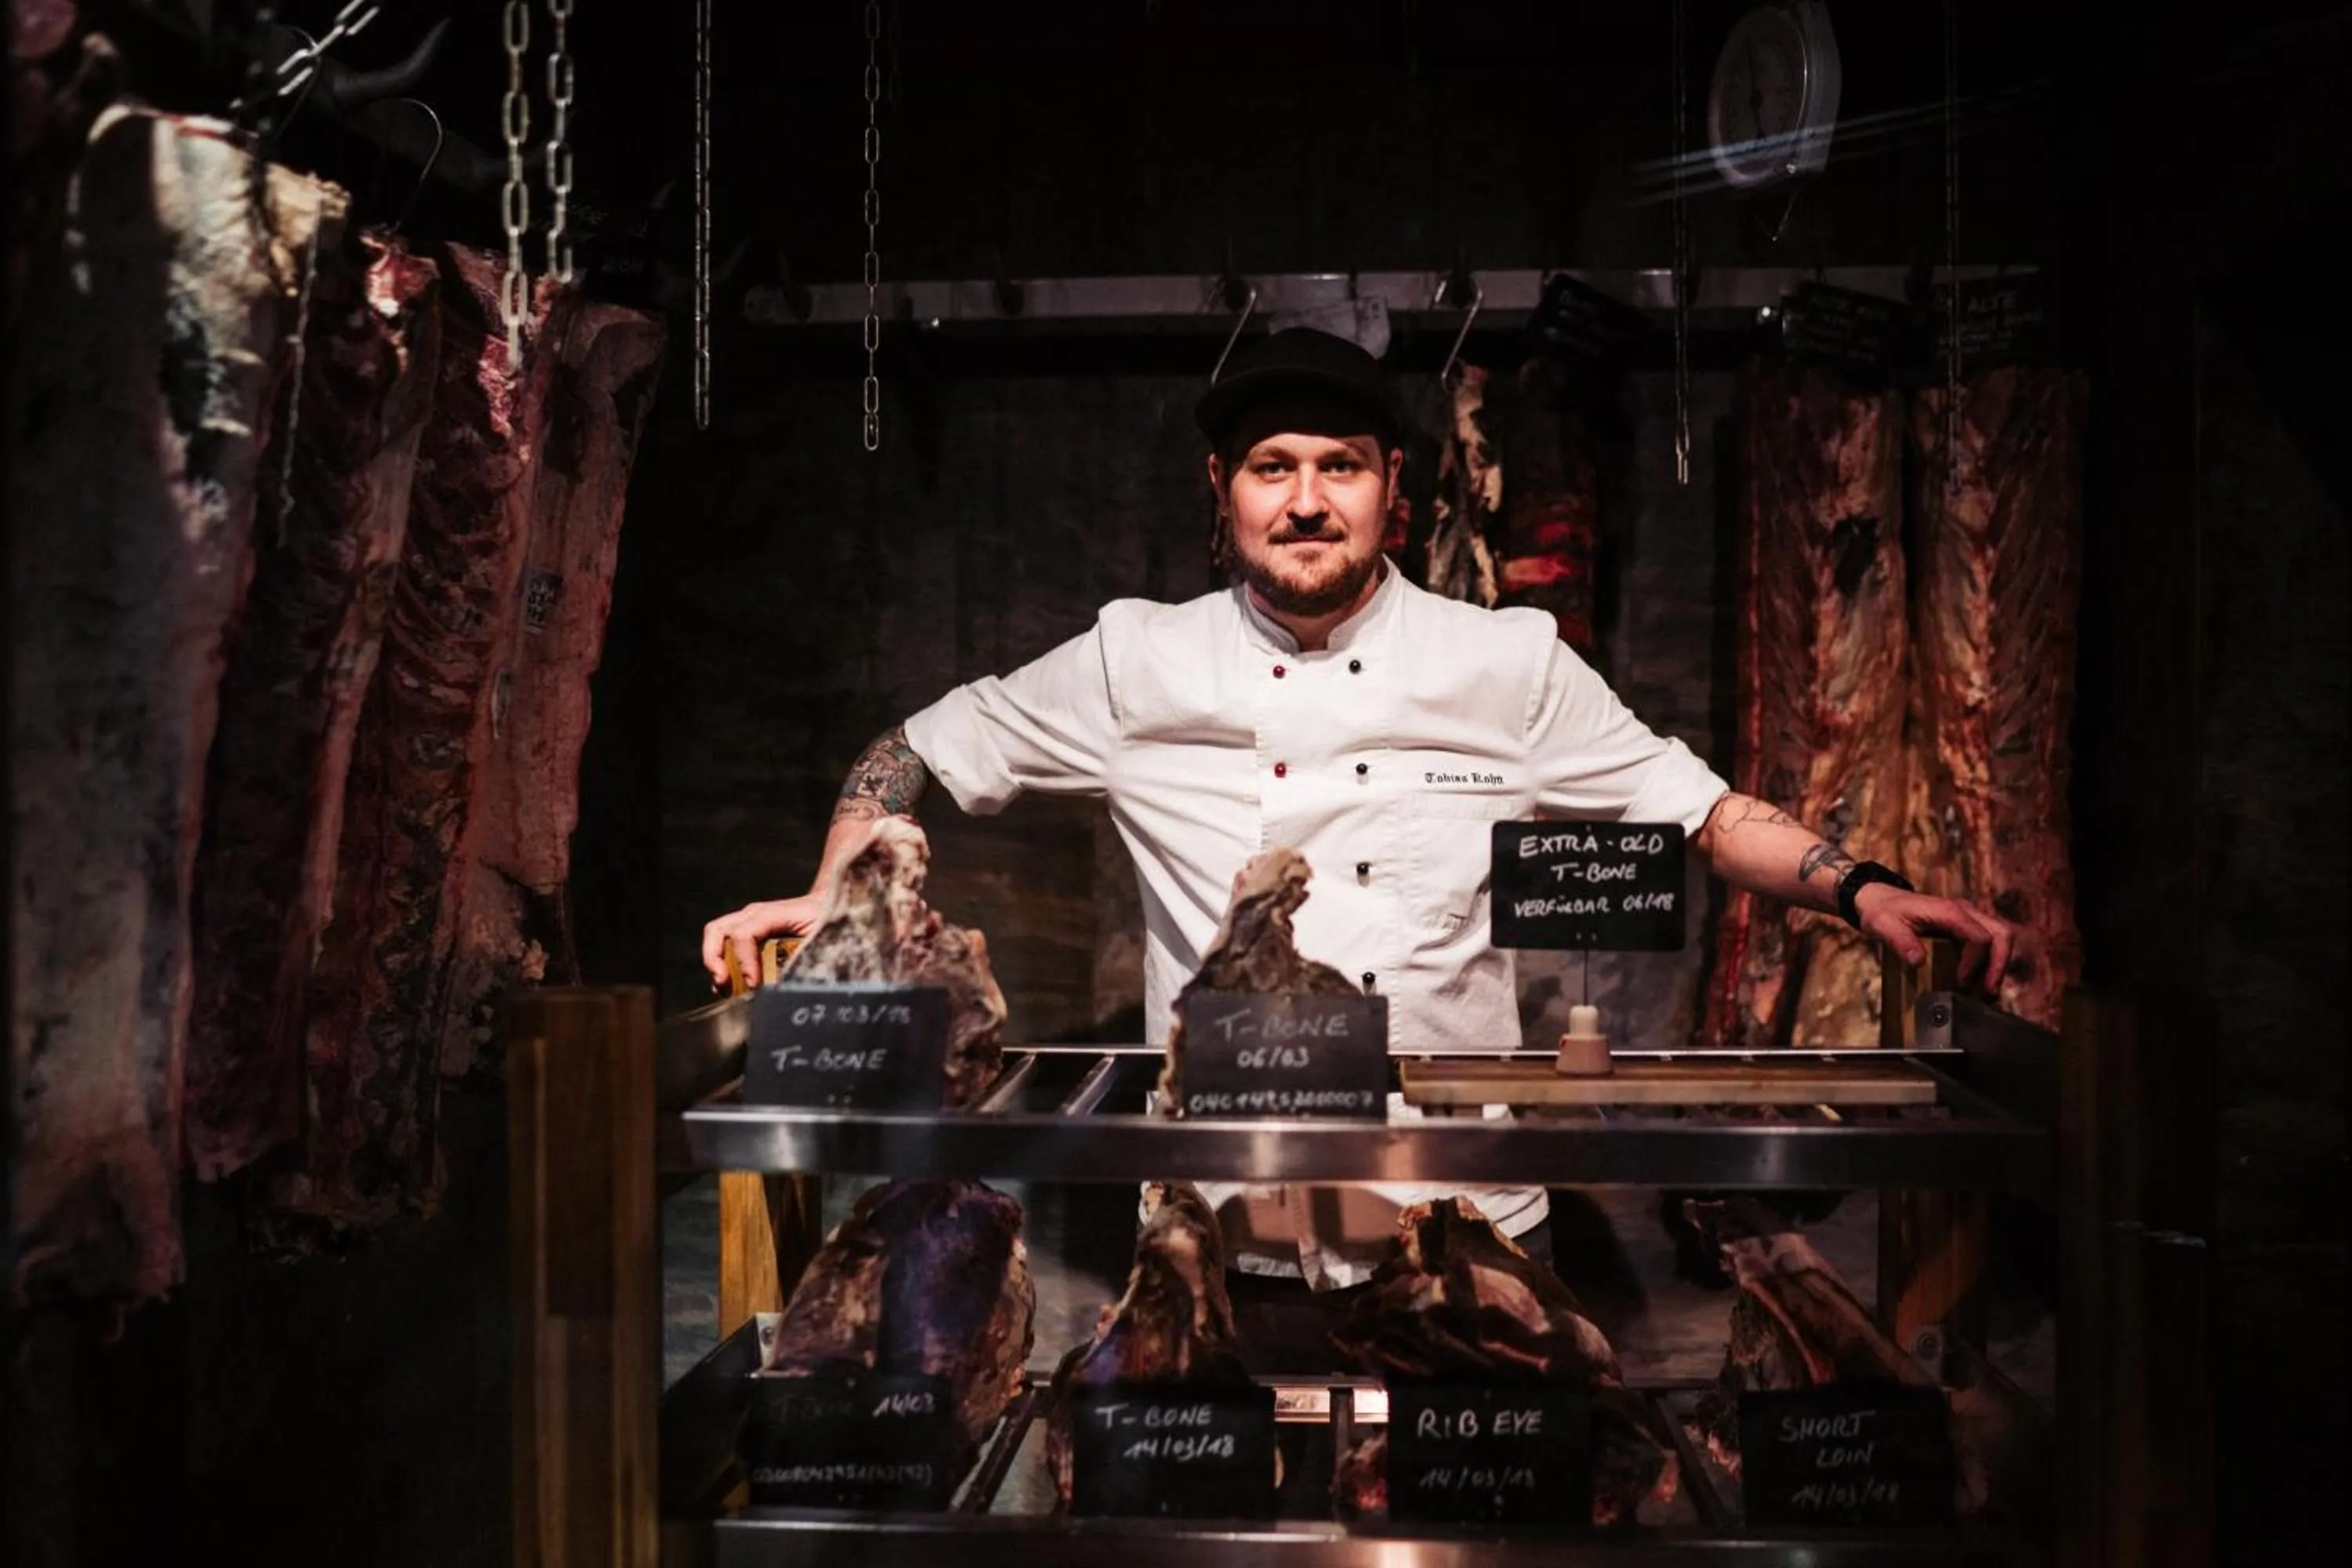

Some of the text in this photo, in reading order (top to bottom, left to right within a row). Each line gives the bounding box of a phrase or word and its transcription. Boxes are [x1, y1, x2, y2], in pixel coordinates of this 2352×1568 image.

[1552, 862, 1636, 882] T-BONE
[1622, 892, 1675, 912] 06/18
[1215, 1007, 1349, 1041] T-BONE
[771, 1045, 887, 1073] T-BONE
[1237, 1047, 1310, 1068] 06/03
[1094, 1403, 1215, 1430] T-BONE
[1417, 1408, 1544, 1440] RIB EYE
[1777, 1410, 1876, 1443] SHORT
[1123, 1434, 1236, 1463] 14/03/18
[1815, 1440, 1875, 1468] LOIN
